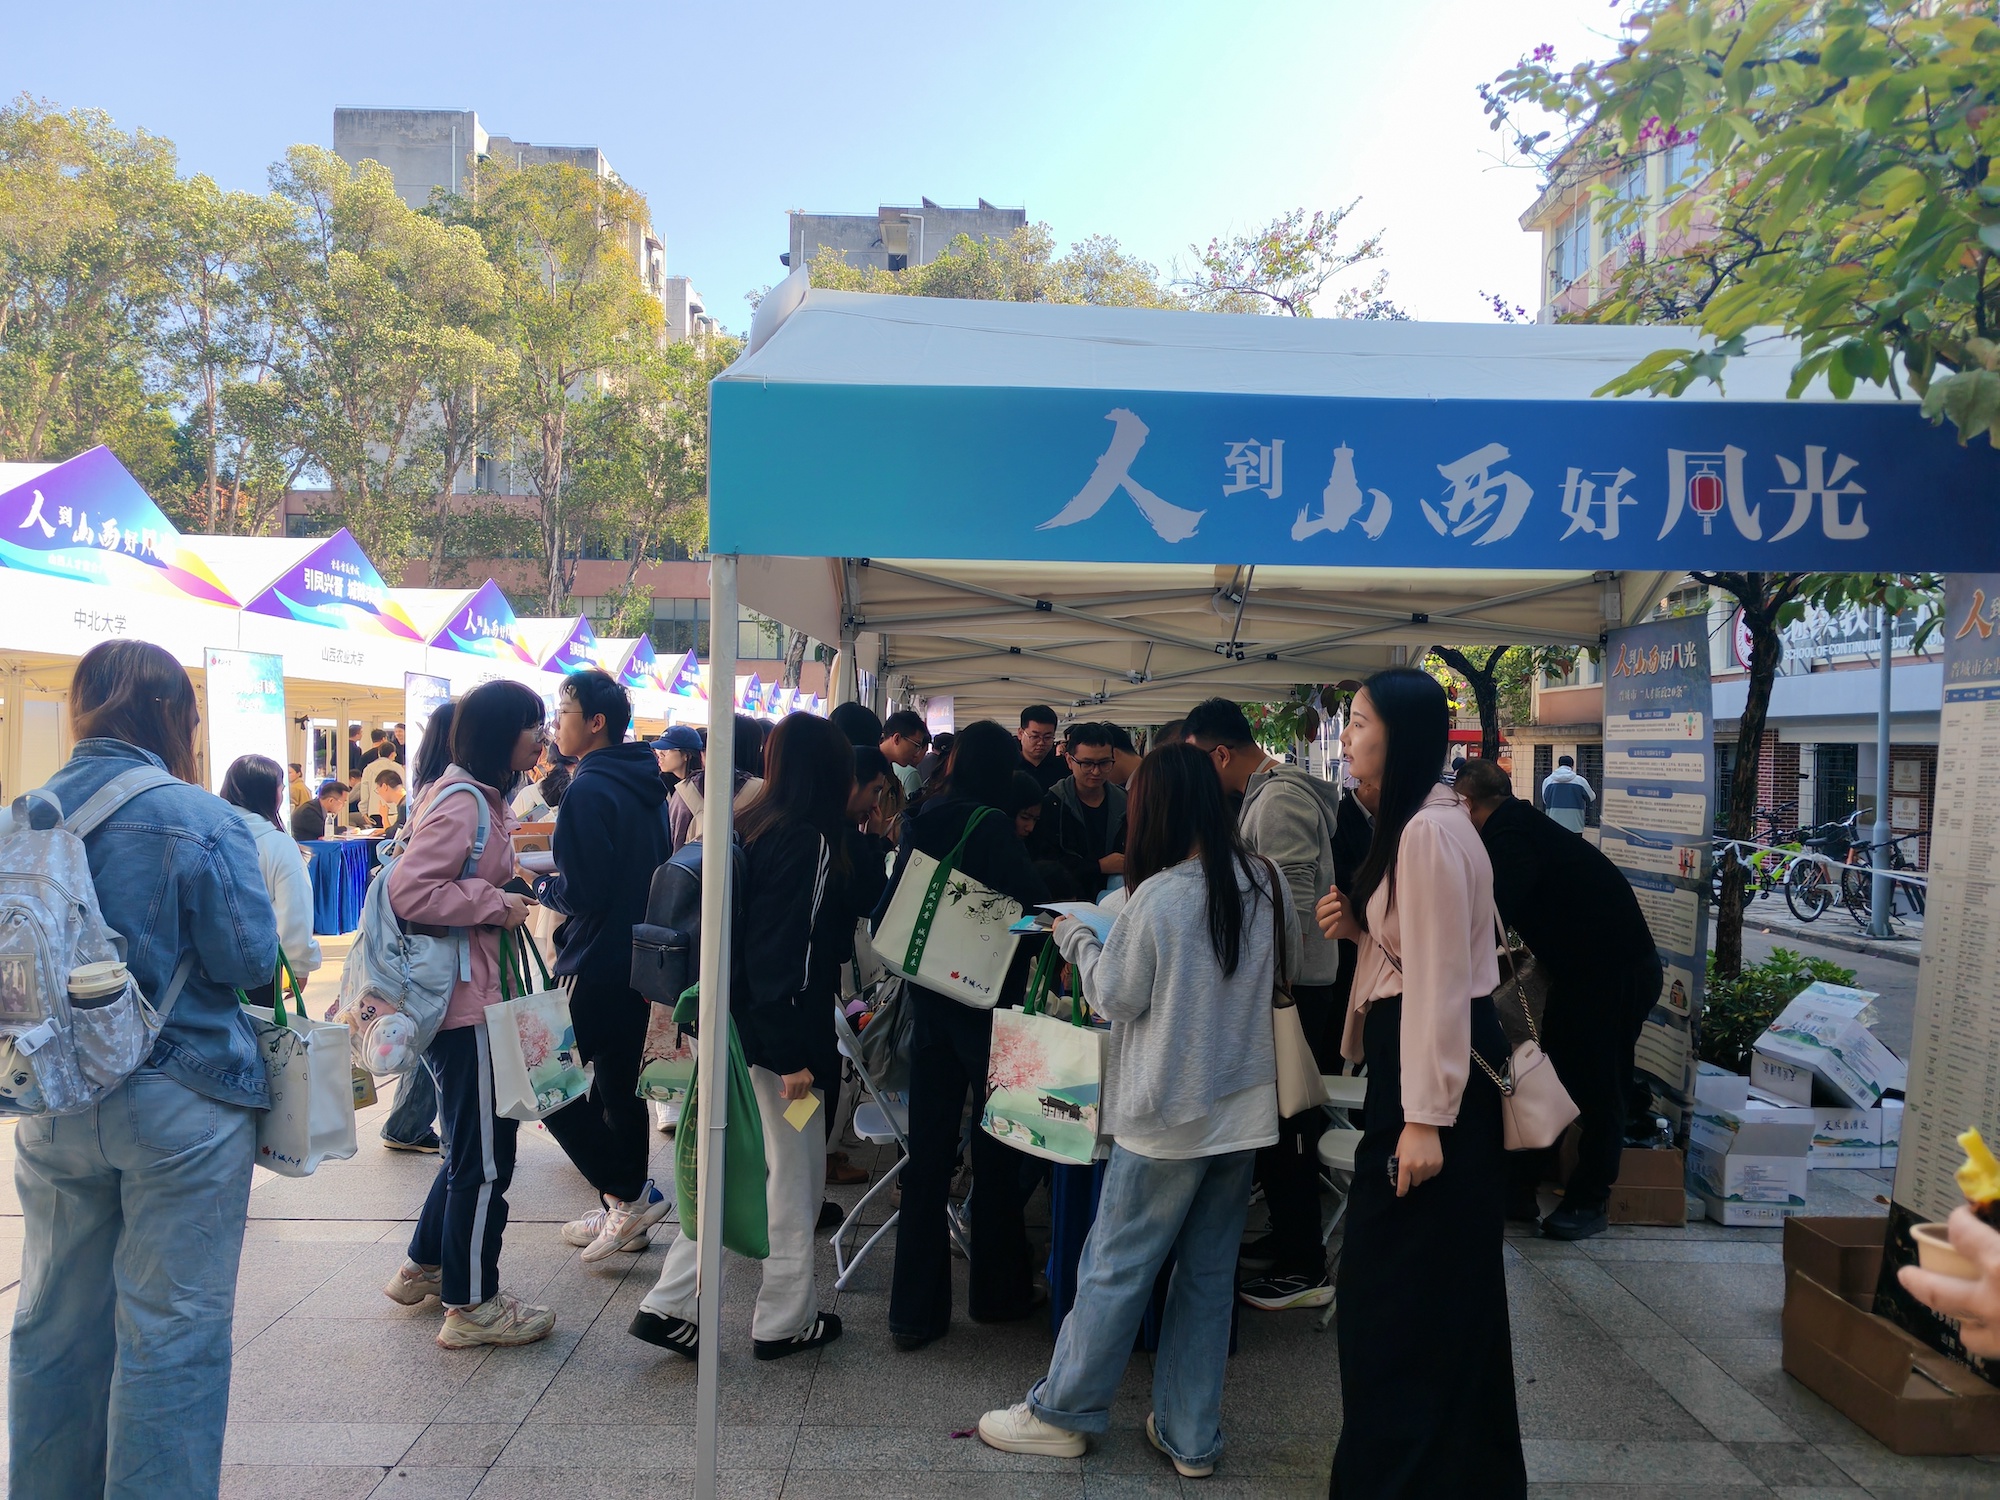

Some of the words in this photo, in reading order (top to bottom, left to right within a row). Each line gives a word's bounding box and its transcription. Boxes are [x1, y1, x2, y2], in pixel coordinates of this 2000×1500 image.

[1036, 407, 1869, 546] 人到山西好风光
[303, 567, 343, 598] 引凤兴晋
[73, 608, 127, 635] 中北大学
[321, 646, 365, 667] 山西农业大学
[1612, 641, 1698, 678] 人到山西好风光
[1783, 647, 1815, 661] SCHOOL
[1816, 645, 1829, 657] OF
[1890, 632, 1945, 649] DUCON
